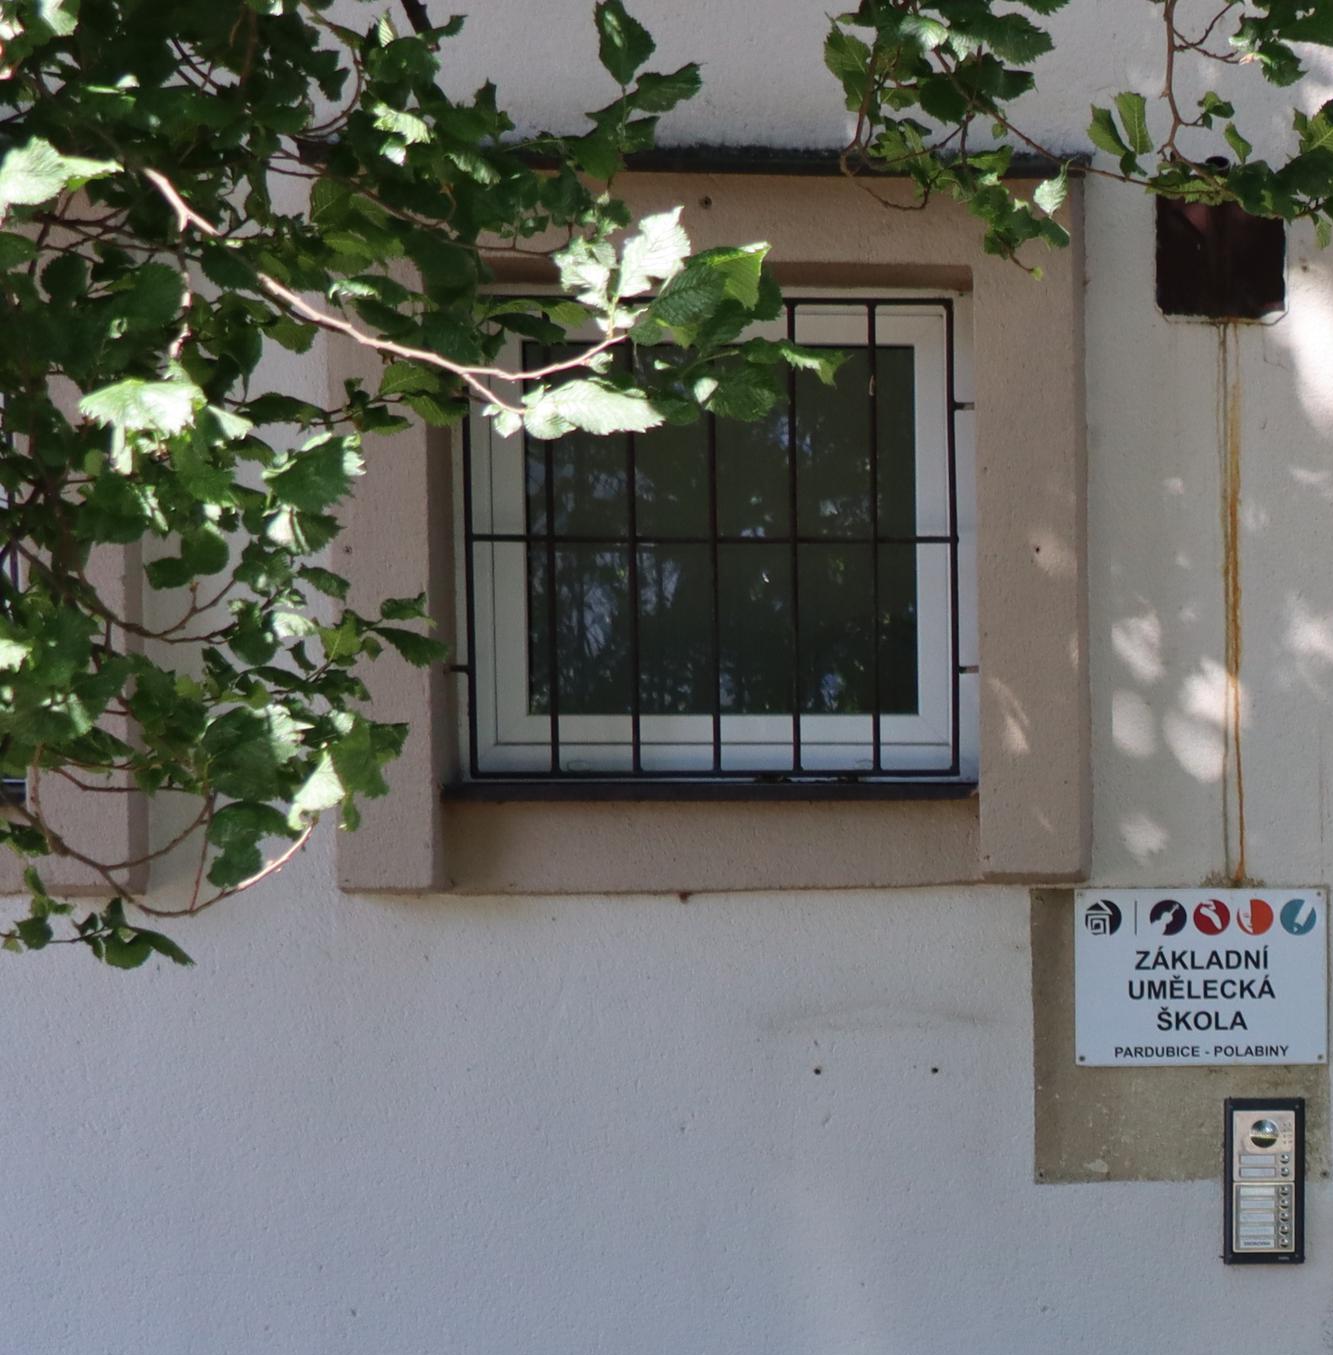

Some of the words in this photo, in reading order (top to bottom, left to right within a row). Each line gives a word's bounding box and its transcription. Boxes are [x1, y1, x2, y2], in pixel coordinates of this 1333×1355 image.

[1134, 944, 1269, 971] ZÁKLADNÍ
[1128, 974, 1276, 1000] UMĚLECKÁ
[1156, 1006, 1248, 1032] ŠKOLA
[1114, 1045, 1200, 1059] PARDUBICE
[1213, 1044, 1289, 1058] POLABINY
